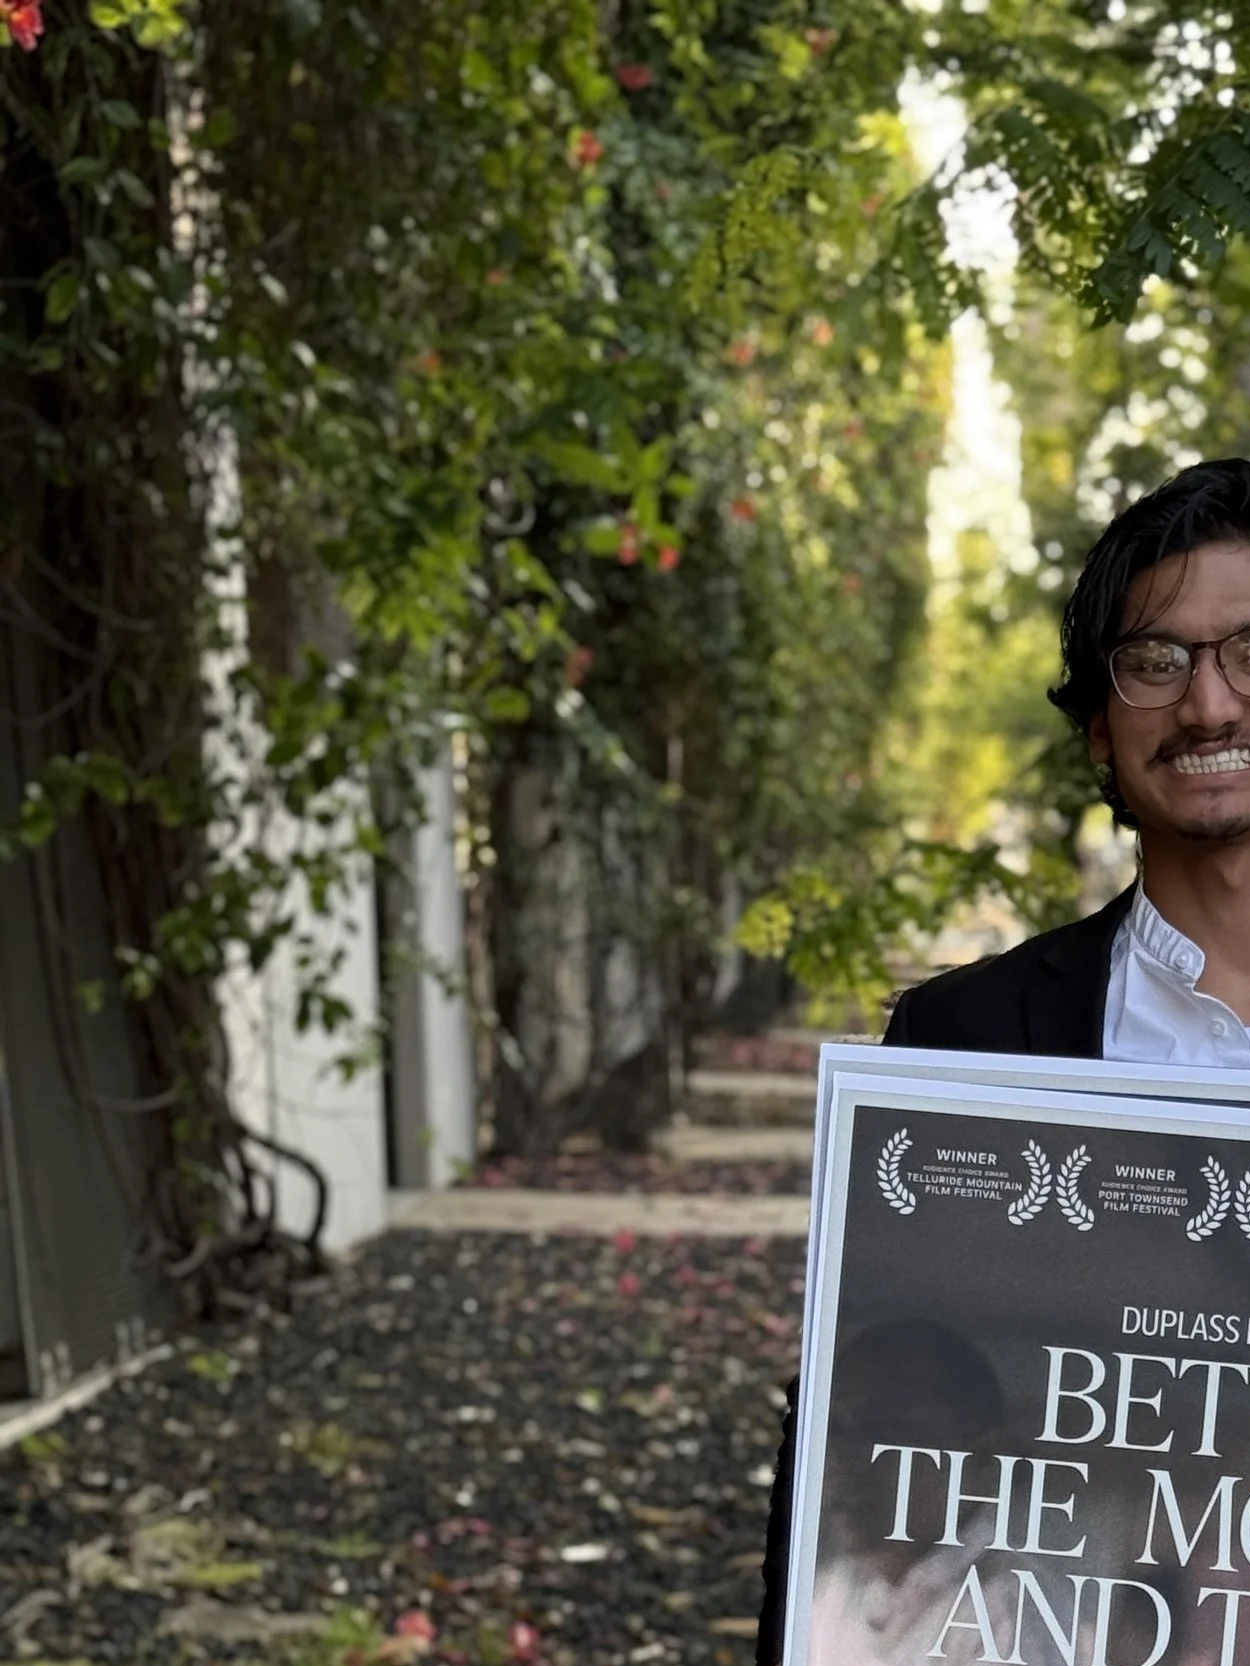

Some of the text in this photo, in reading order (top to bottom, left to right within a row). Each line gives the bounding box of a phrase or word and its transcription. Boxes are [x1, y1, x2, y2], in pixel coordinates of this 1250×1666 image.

[936, 1147, 997, 1166] WINNER
[906, 1172, 1022, 1192] TELLURIDE MOUNTAIN
[1114, 1165, 1175, 1183] WINNER
[925, 1184, 1002, 1200] FILM FESTIVAL
[1098, 1190, 1187, 1208] PORT TOWNSEND
[1103, 1201, 1180, 1217] FILM FESTIVAL
[1121, 1306, 1240, 1346] DUPLASS
[871, 1443, 1091, 1559] THE
